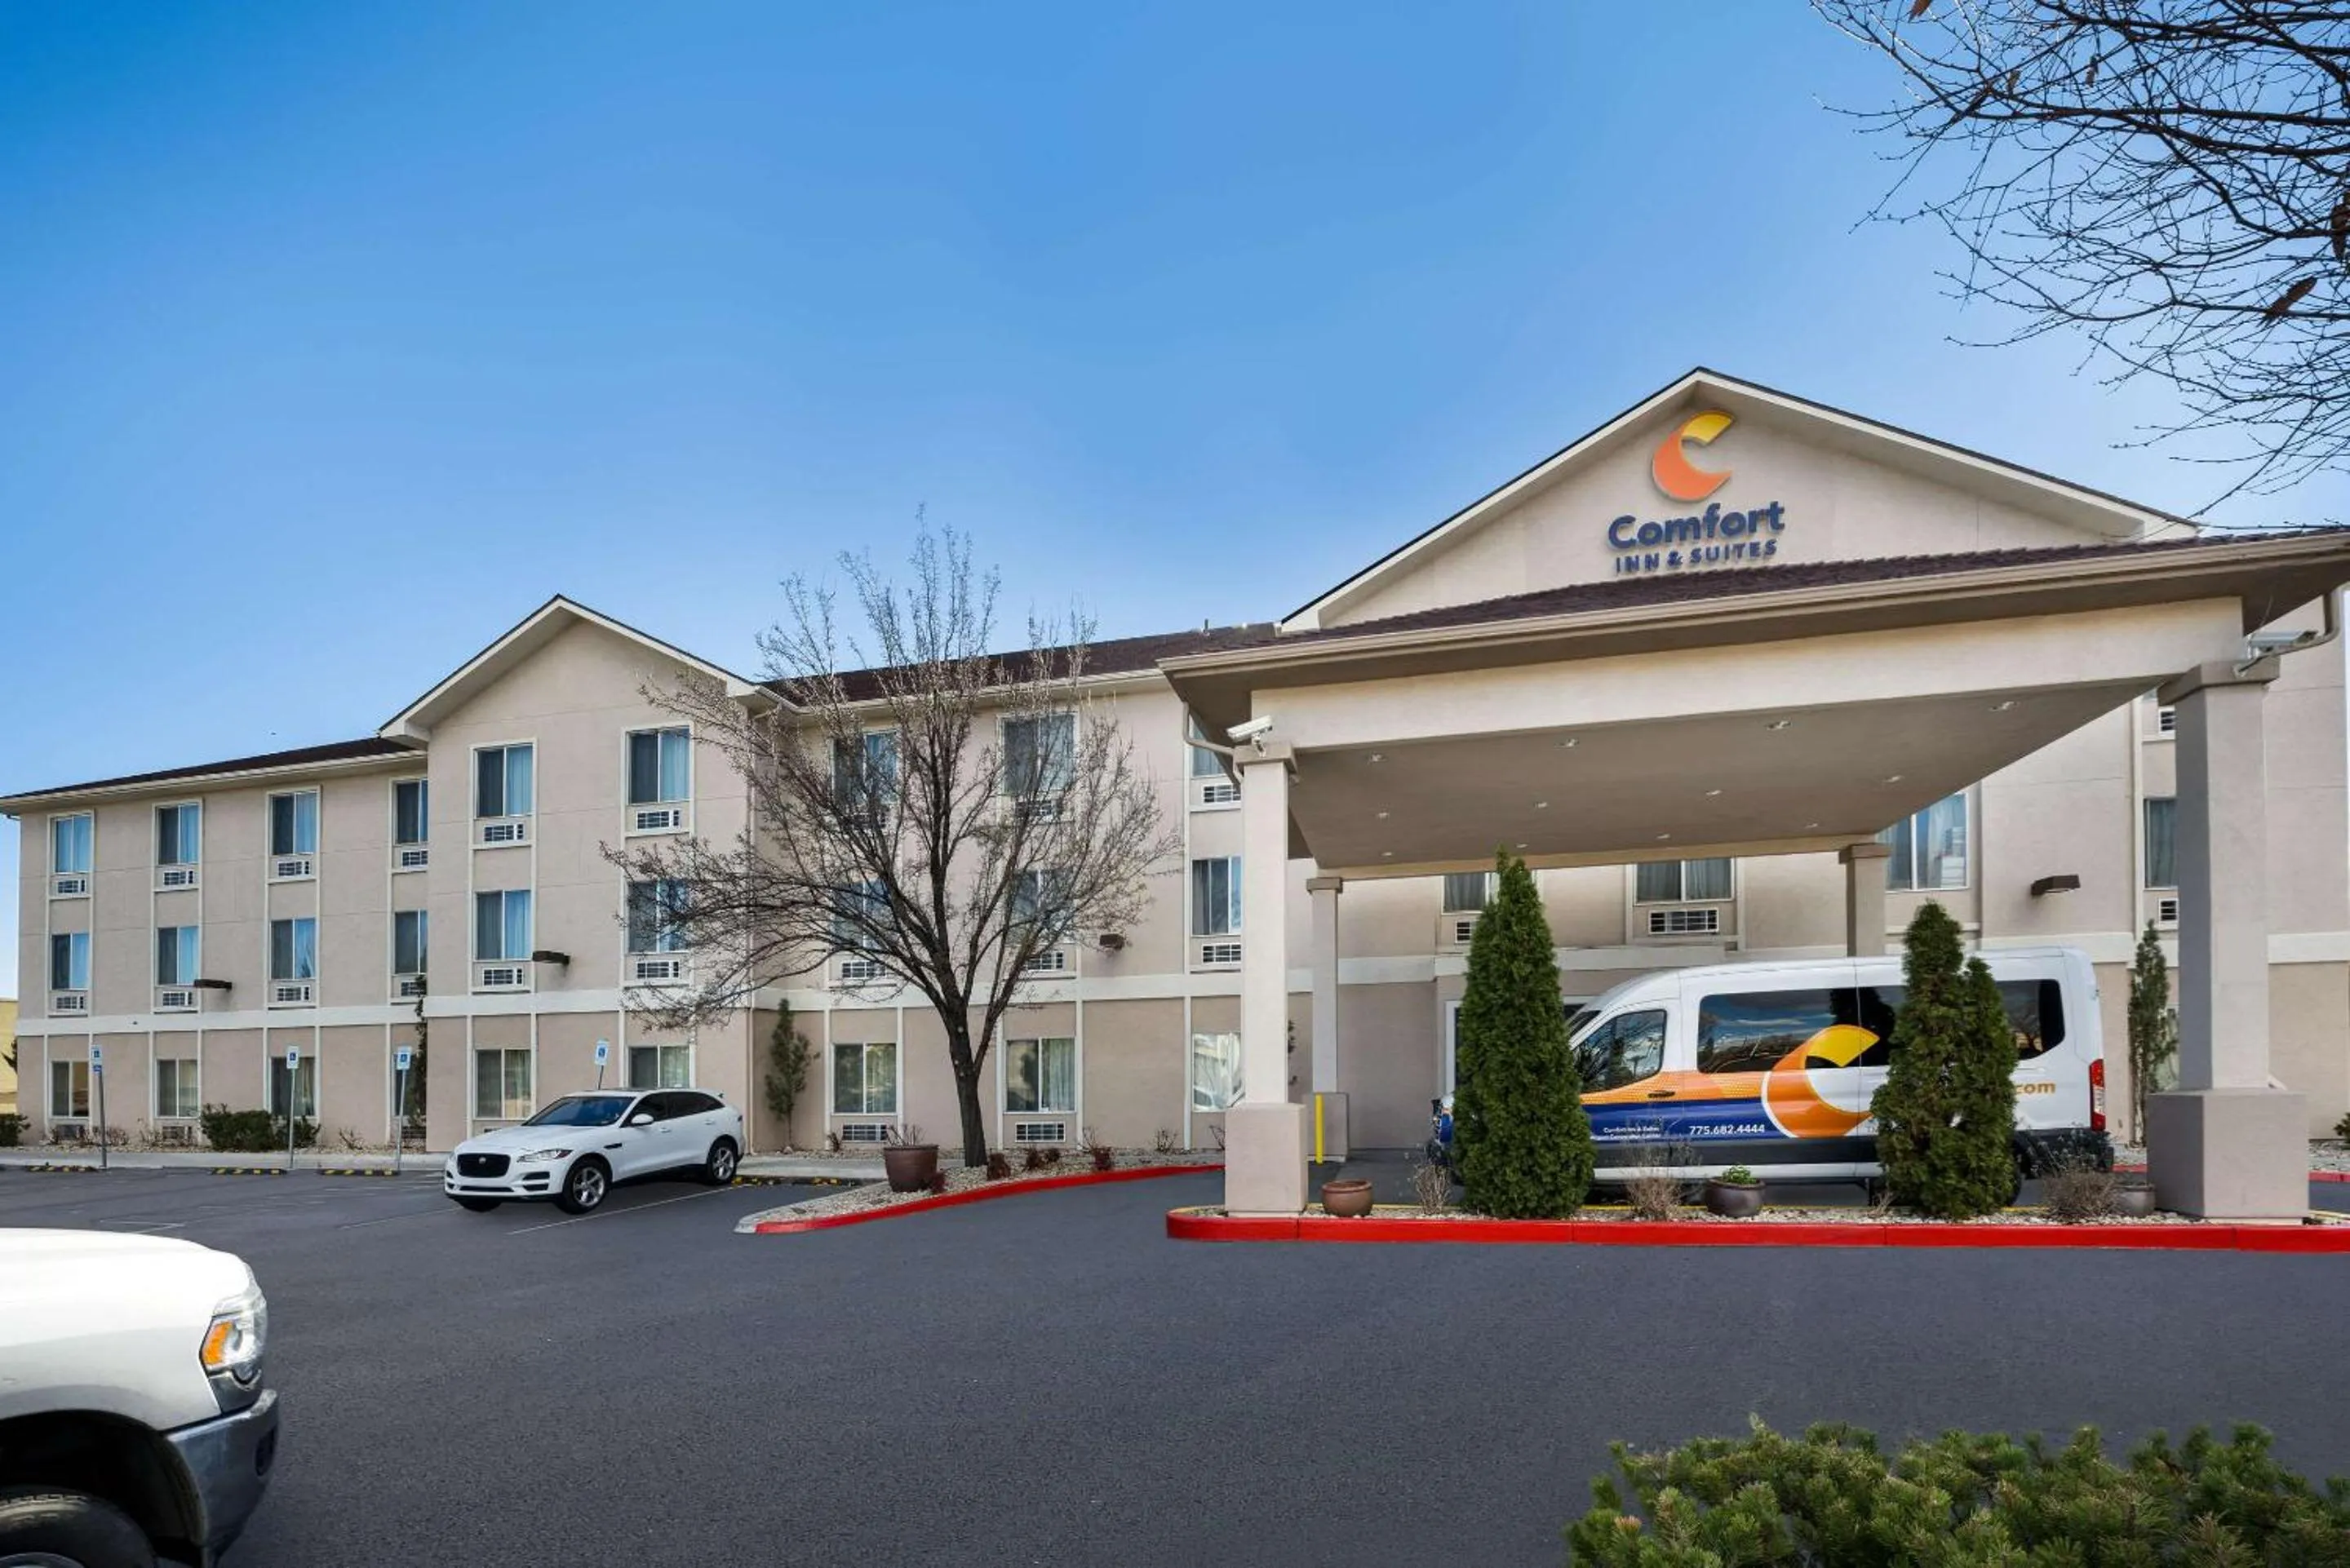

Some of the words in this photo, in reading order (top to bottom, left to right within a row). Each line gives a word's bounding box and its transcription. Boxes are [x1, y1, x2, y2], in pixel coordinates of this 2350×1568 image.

[1607, 501, 1785, 549] Comfort
[1616, 553, 1660, 574] INN
[1667, 551, 1683, 568] &
[1690, 539, 1777, 564] SUITES
